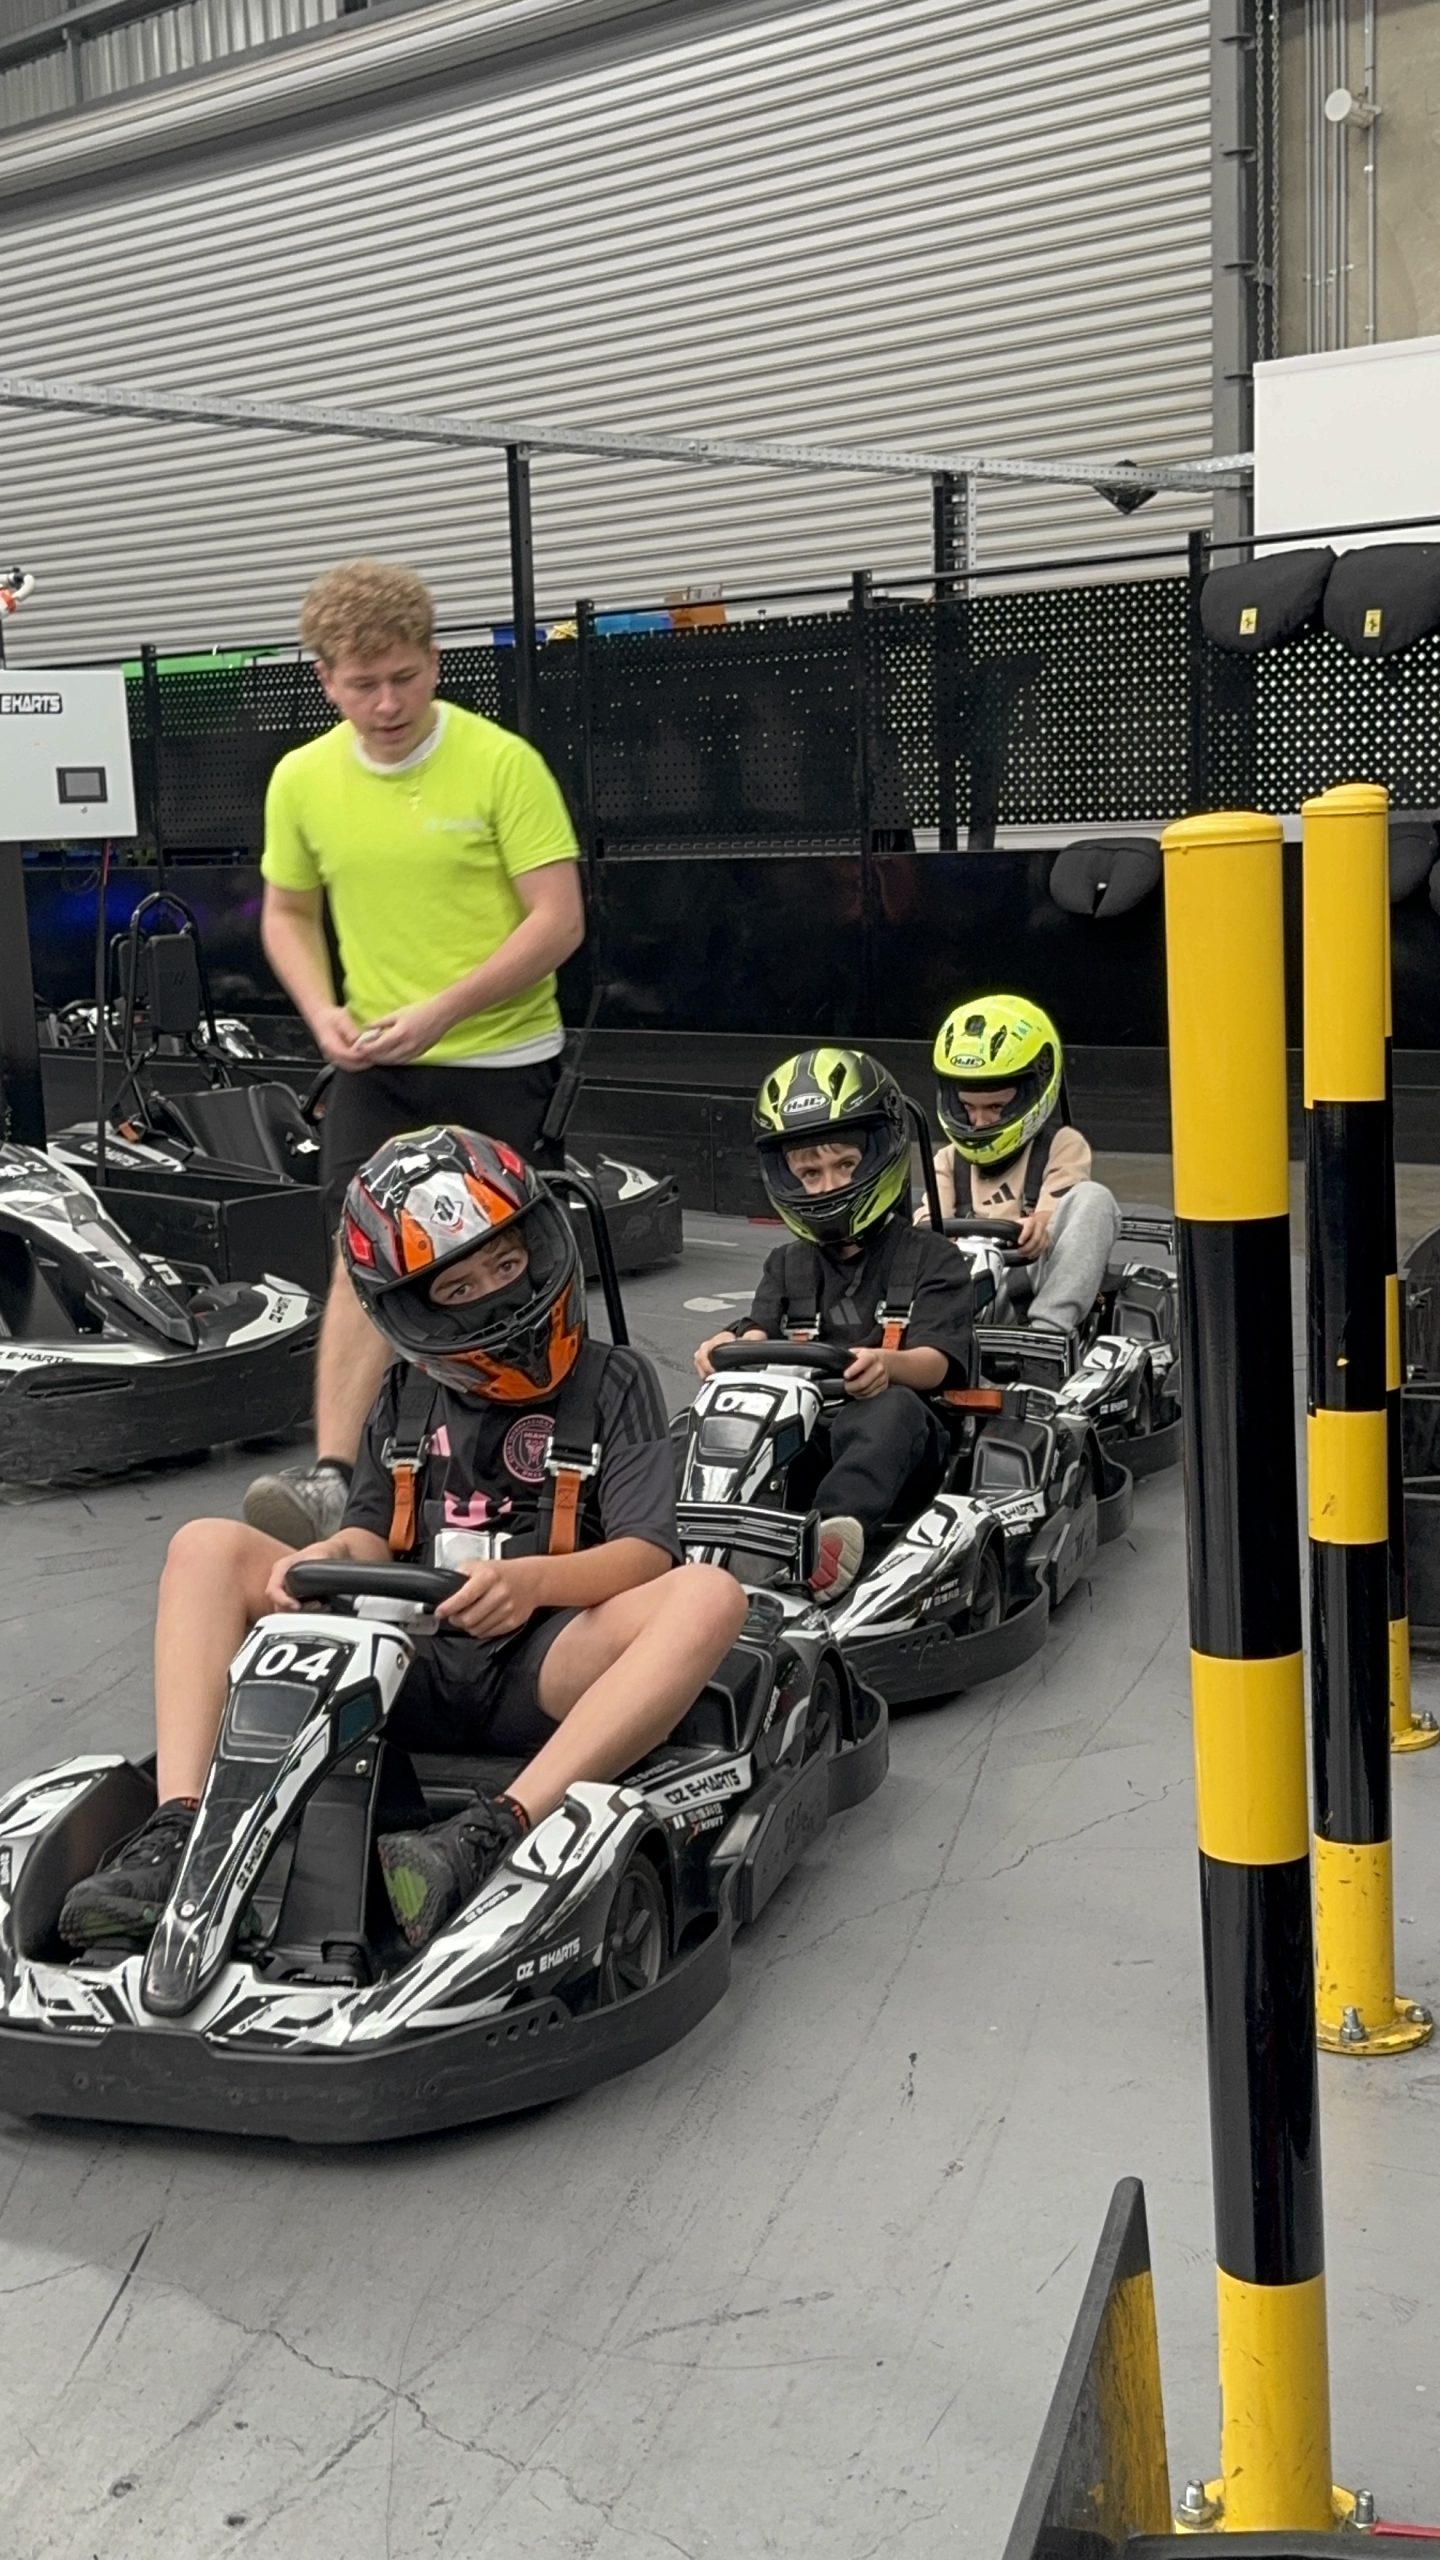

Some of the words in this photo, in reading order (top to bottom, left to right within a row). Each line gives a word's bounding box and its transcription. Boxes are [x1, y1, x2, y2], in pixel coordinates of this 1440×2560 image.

[787, 1096, 825, 1112] HJC
[255, 1643, 338, 1682] 04
[664, 1787, 690, 1805] OZ
[516, 1960, 535, 1982] OZ
[539, 1936, 580, 1974] EKARTS
